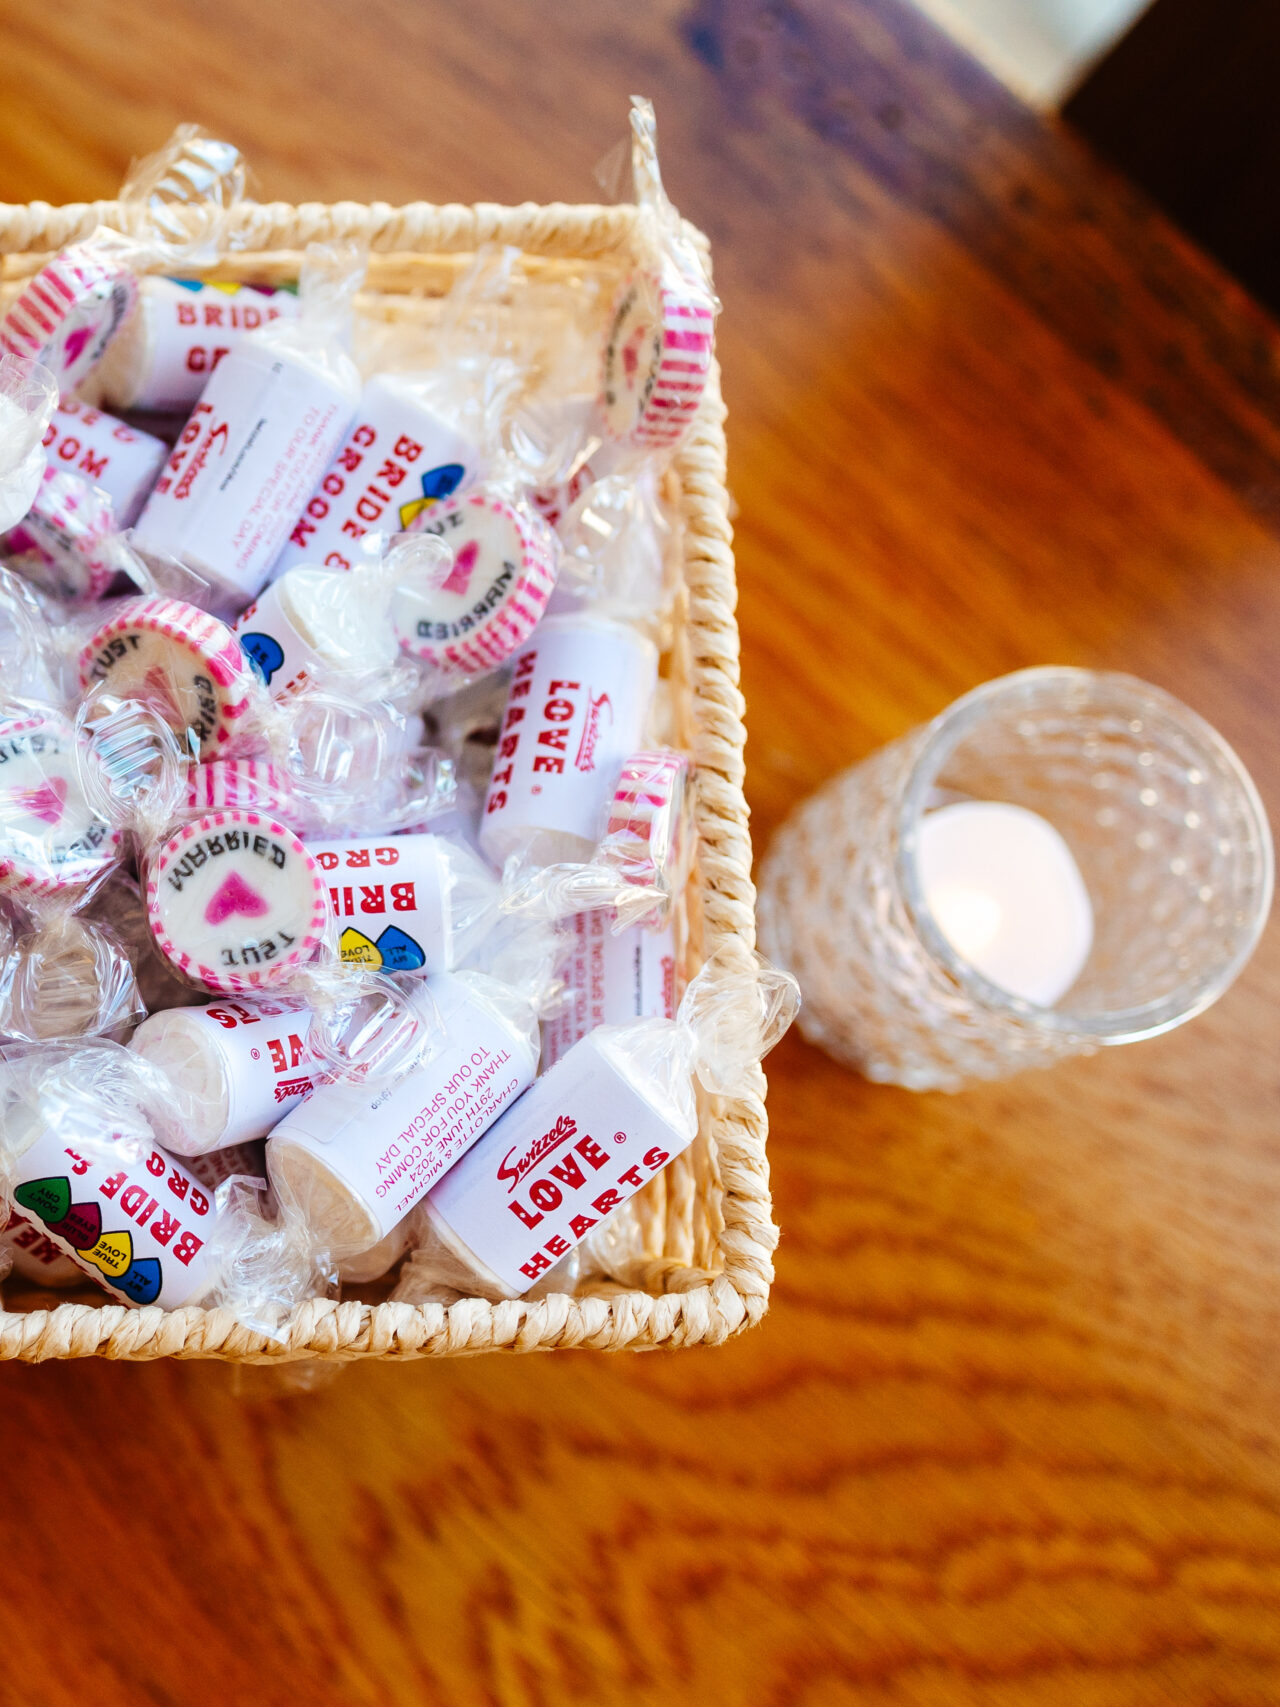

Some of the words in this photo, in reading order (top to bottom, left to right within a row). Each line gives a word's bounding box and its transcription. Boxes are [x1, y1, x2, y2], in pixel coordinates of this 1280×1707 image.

[154, 401, 214, 497] LOVE
[290, 424, 378, 549] GROOM
[341, 434, 424, 538] BRIDE
[90, 633, 141, 681] JUST
[488, 650, 539, 815] HEARTS
[532, 679, 581, 775] LOVE
[442, 1062, 473, 1096] OUR
[468, 1043, 490, 1067] TO
[469, 1046, 511, 1093] THANK
[395, 1090, 447, 1148] SPECIAL
[444, 1088, 473, 1120] YOU
[451, 1077, 521, 1150] CHARLOTTE
[462, 1085, 495, 1121] 29TH
[419, 1116, 448, 1147] FOR
[432, 1117, 467, 1153] JUNE
[442, 1147, 454, 1160] &
[496, 1114, 578, 1195] Swizzels
[372, 1142, 401, 1175] DAY
[373, 1143, 424, 1199] COMING
[406, 1149, 437, 1183] 2024
[507, 1134, 612, 1231] LOVE
[391, 1158, 445, 1214] MICHAEL
[98, 1171, 206, 1267] BRIDE
[518, 1146, 671, 1281] HEARTS
[91, 1246, 122, 1270] TRUE
[98, 1240, 128, 1262] LOVE
